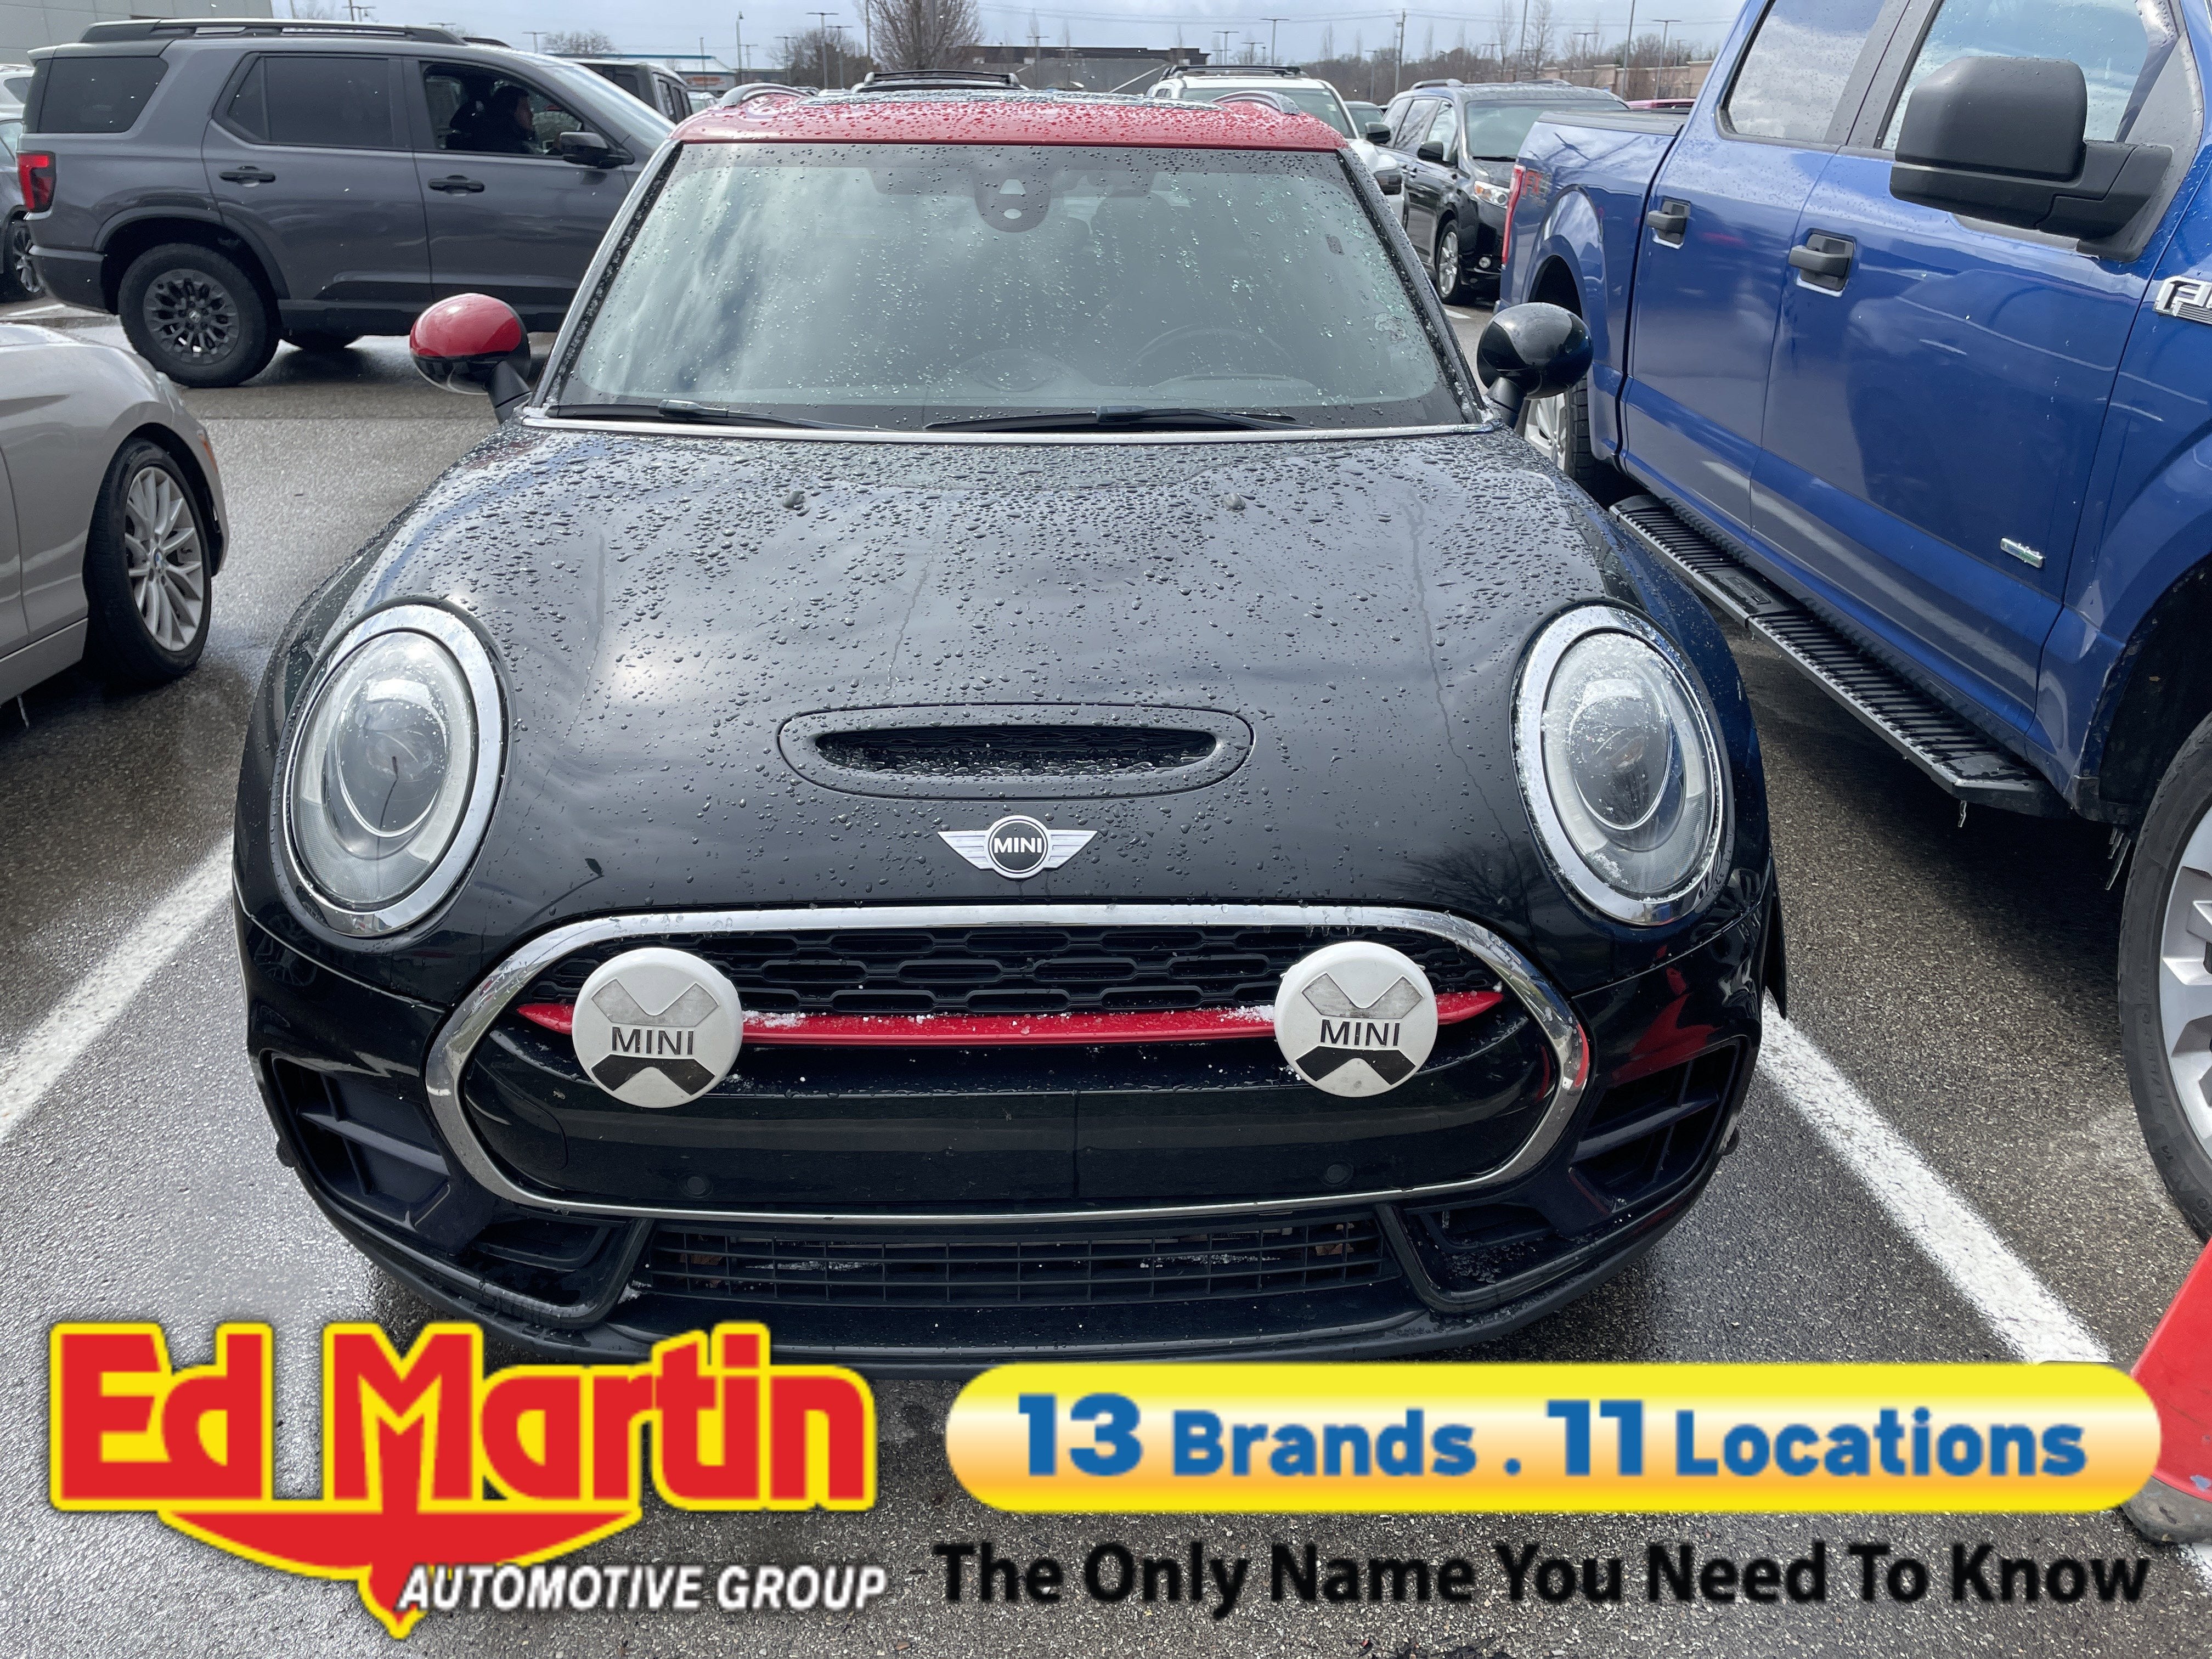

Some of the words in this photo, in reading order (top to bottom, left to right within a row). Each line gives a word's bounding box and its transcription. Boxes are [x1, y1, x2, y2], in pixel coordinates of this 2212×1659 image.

[993, 837, 1043, 854] MINI
[611, 1026, 694, 1056] MINI
[1319, 1019, 1400, 1046] MINI
